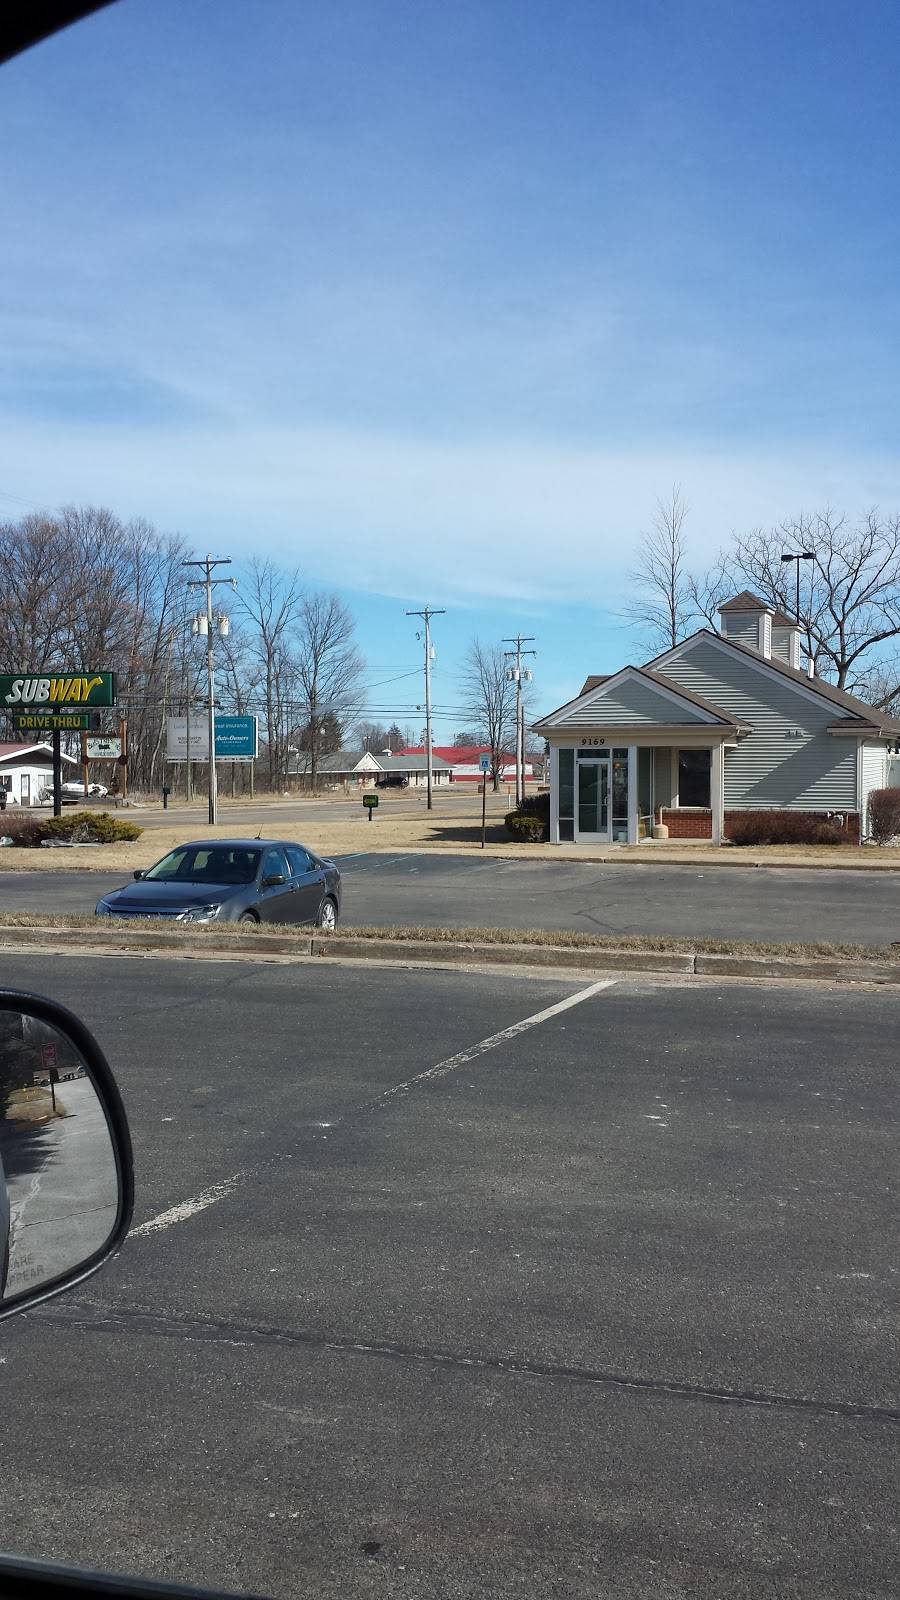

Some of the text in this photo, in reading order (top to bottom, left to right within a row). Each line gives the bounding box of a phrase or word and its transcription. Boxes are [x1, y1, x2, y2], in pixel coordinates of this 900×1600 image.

[5, 676, 97, 704] SUBWAY
[20, 717, 81, 728] DRIVE THRU
[581, 738, 605, 746] 9169
